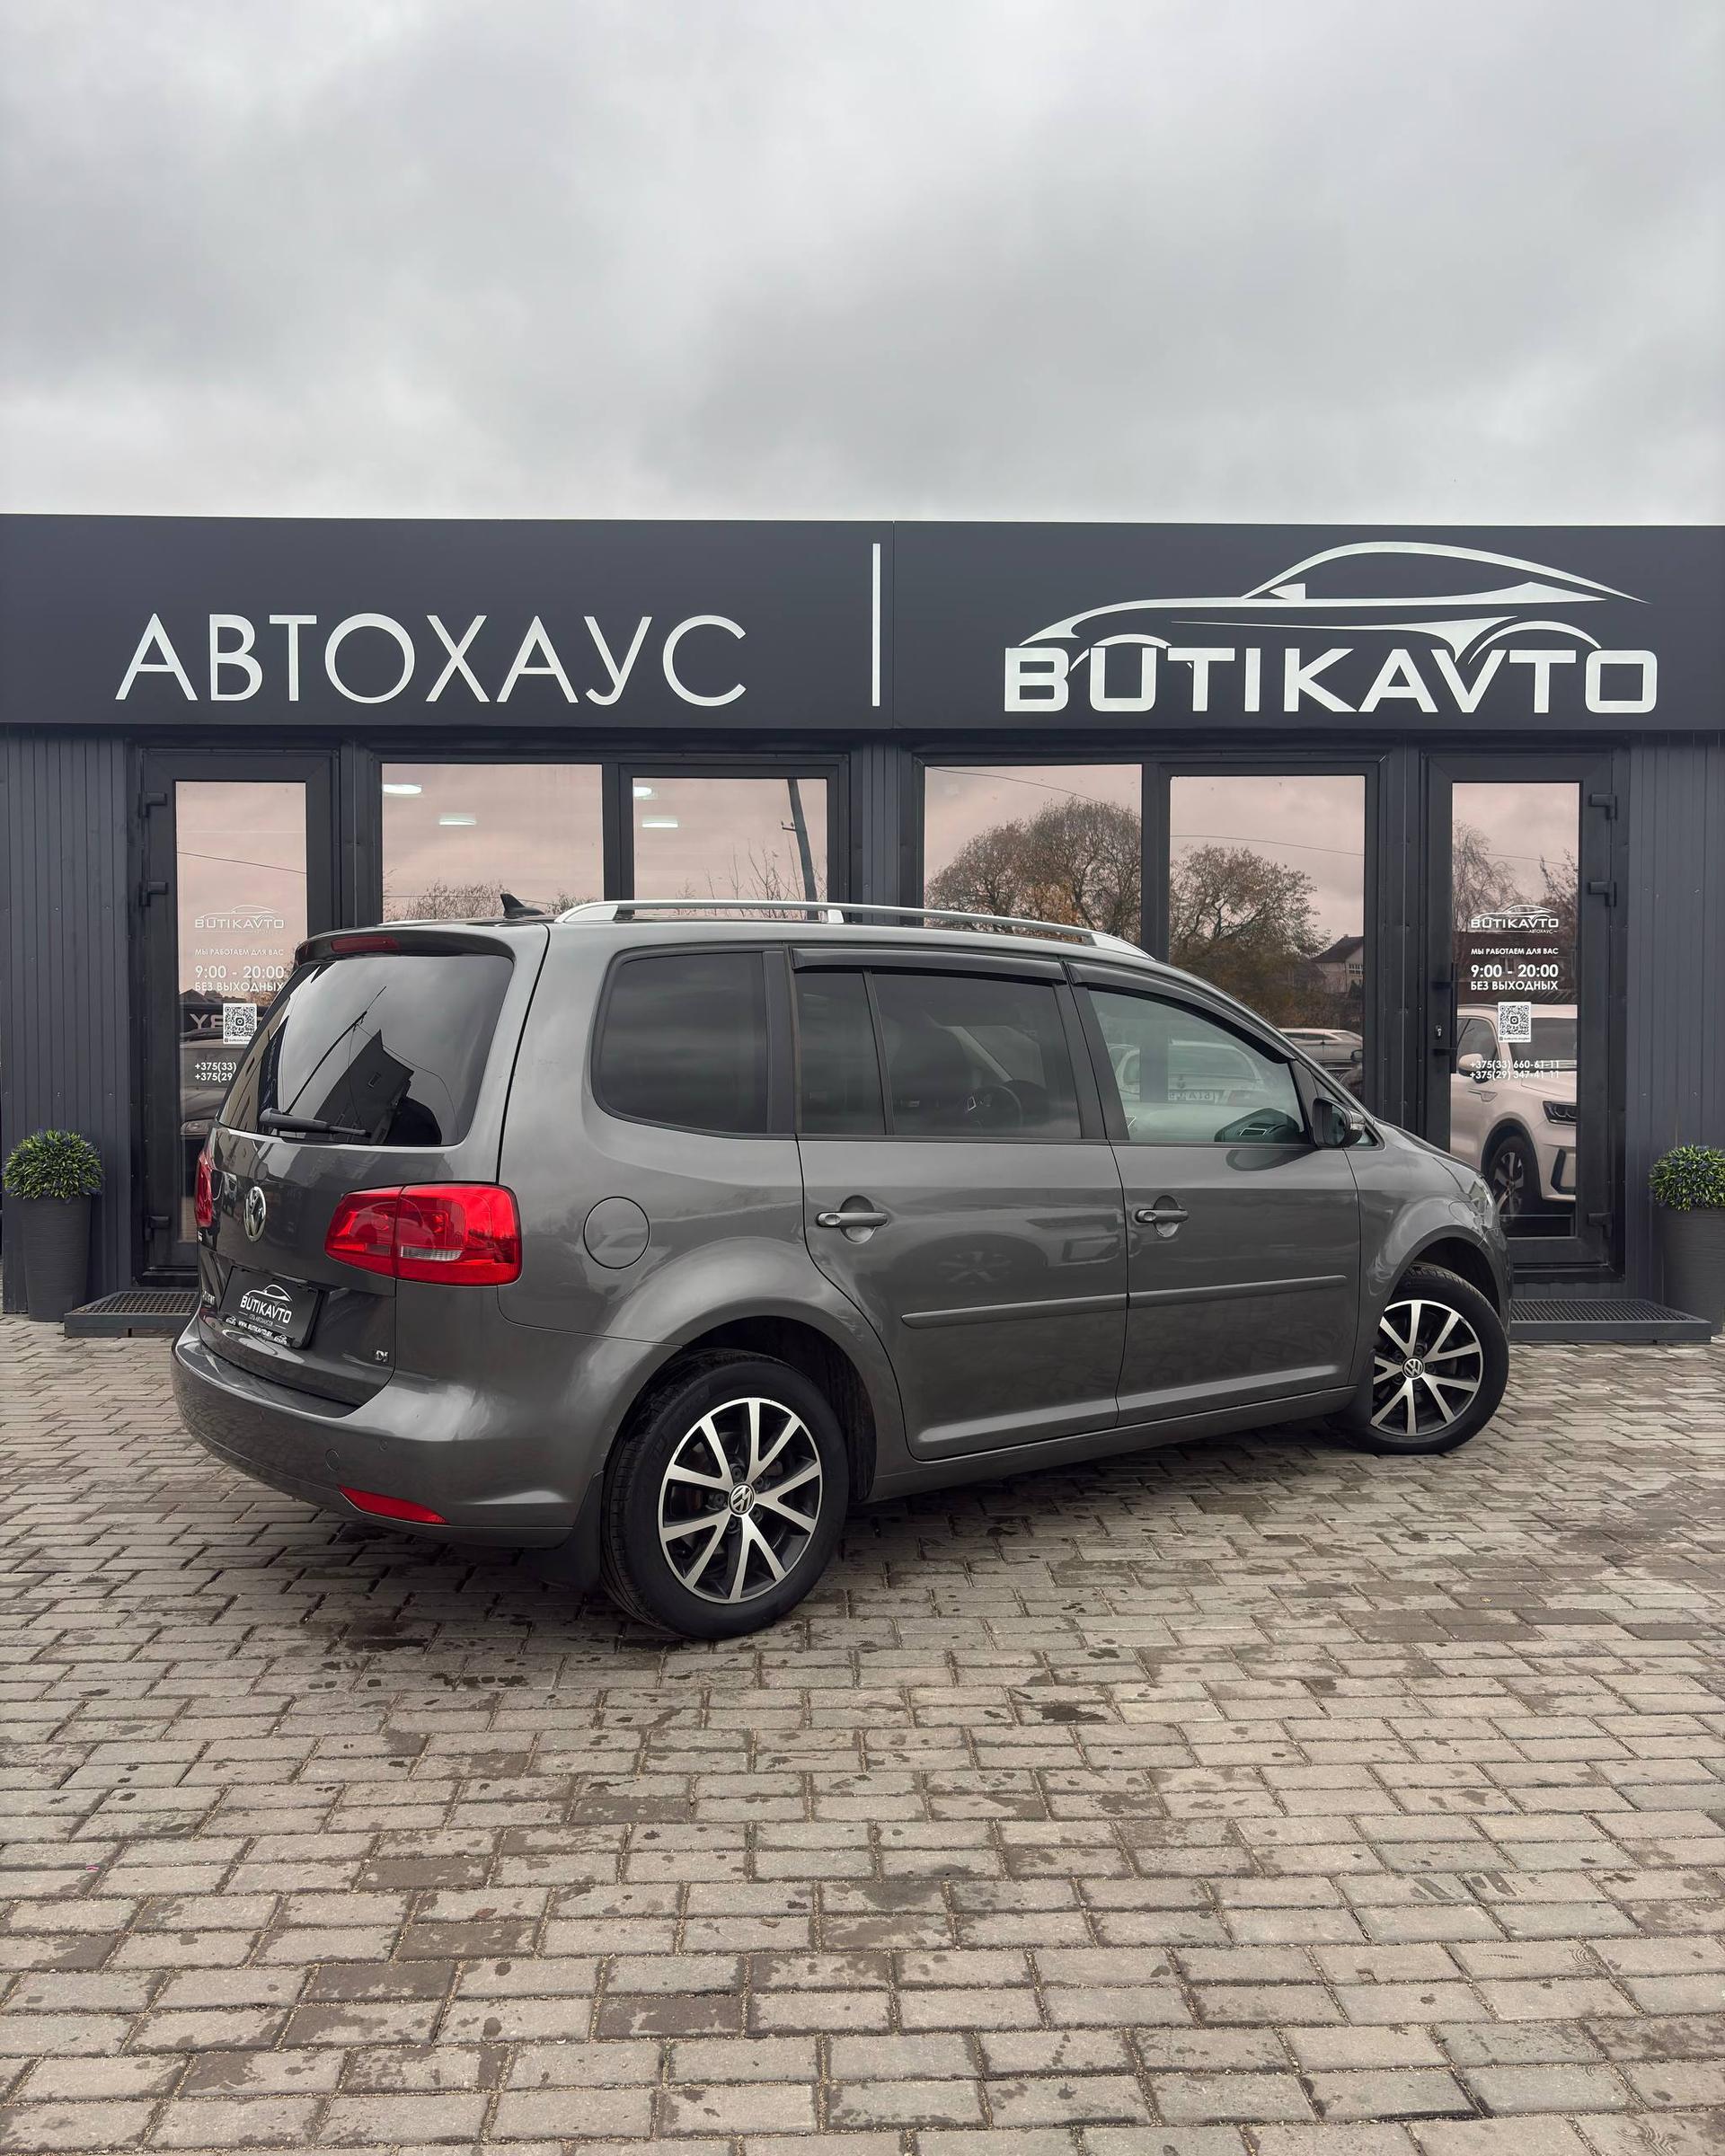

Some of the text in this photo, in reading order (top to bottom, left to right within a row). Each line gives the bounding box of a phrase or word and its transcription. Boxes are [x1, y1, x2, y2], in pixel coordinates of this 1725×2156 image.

[115, 613, 747, 707] АВТОХАУС
[1004, 646, 1658, 713] BUTIKAVTO
[194, 919, 284, 929] BUTIKAVTO
[1471, 918, 1559, 929] BUTIKAVTO
[1544, 947, 1559, 955] ВАС
[195, 965, 227, 978] 9:00
[243, 965, 285, 978] 20:00
[1471, 964, 1502, 977] 9:00
[1517, 964, 1559, 977] 20:00
[195, 982, 284, 992] БЕЗ ВЫХОДНЫХ
[1471, 981, 1559, 991] БЕЗ ВЫХОДНЫХ
[194, 1062, 237, 1074] +375(33)
[1470, 1060, 1559, 1072] +375(33) 660-61-11
[194, 1073, 234, 1082] +375(29
[1470, 1070, 1559, 1081] +375(29) 347-41-11
[240, 1294, 292, 1324] BUTIKAVTO
